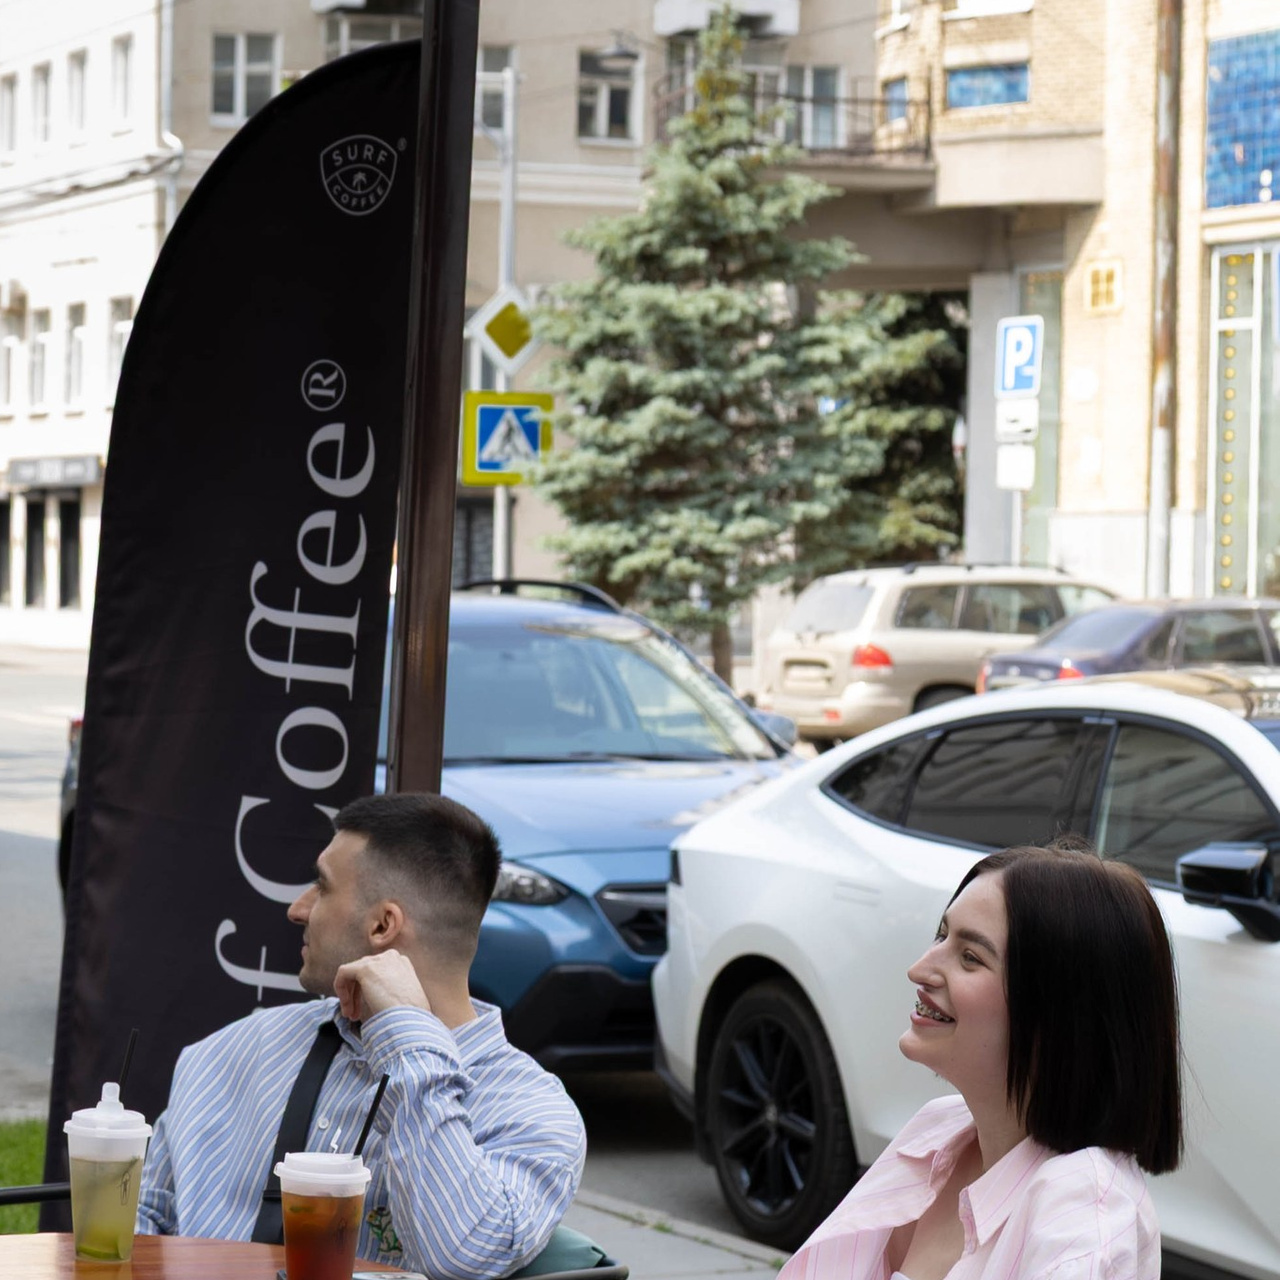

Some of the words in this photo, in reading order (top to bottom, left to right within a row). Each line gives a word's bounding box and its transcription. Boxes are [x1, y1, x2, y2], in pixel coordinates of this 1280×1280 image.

[332, 144, 388, 166] SURF
[333, 185, 384, 208] COFFEE
[1003, 326, 1033, 390] P
